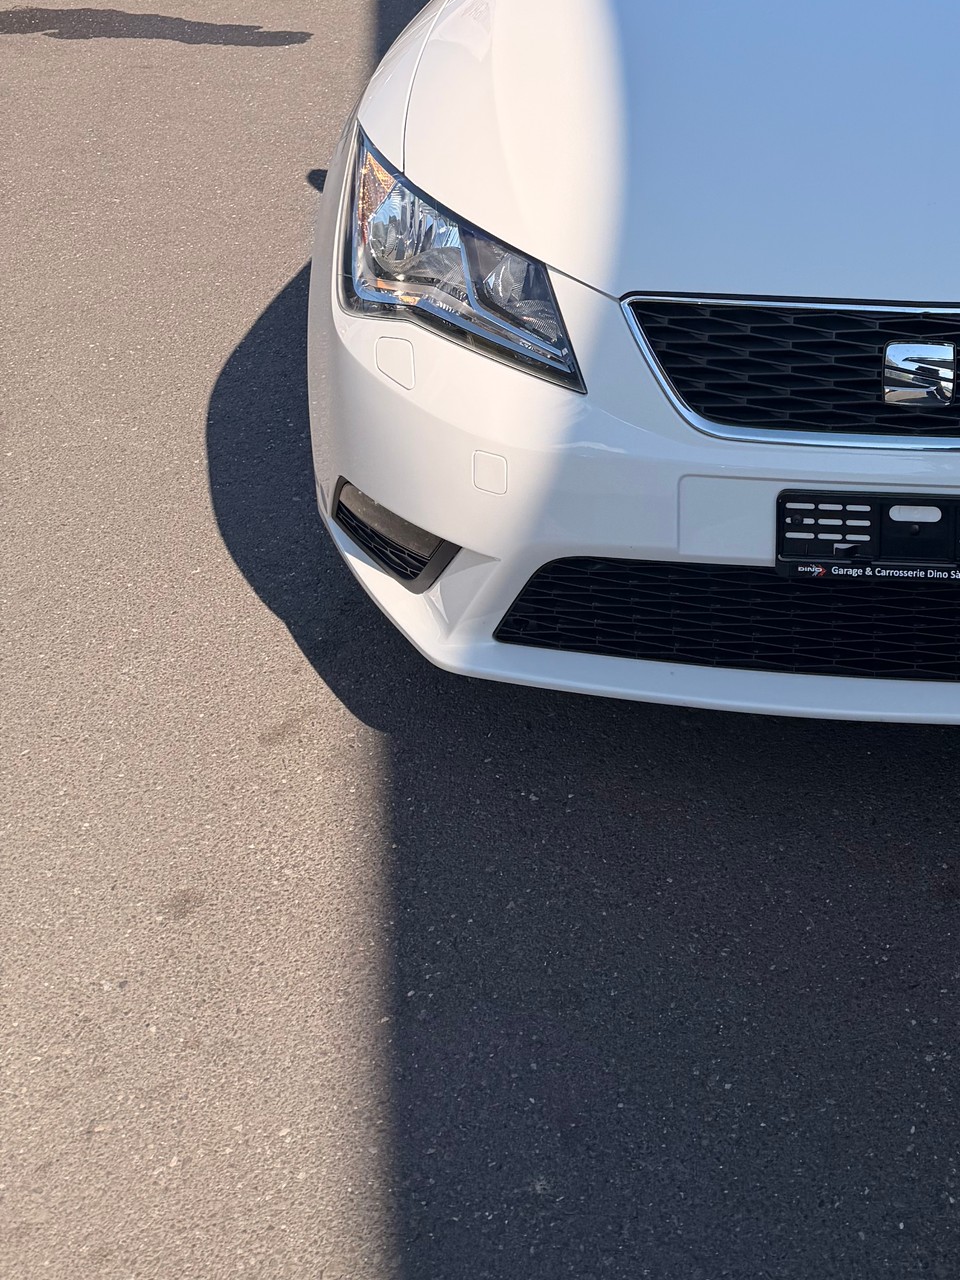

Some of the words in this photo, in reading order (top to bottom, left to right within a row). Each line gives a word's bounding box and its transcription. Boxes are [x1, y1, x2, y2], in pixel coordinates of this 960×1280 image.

[831, 566, 863, 577] Garage
[865, 567, 873, 576] &
[875, 568, 925, 577] Carrosserie
[927, 569, 948, 579] Dino
